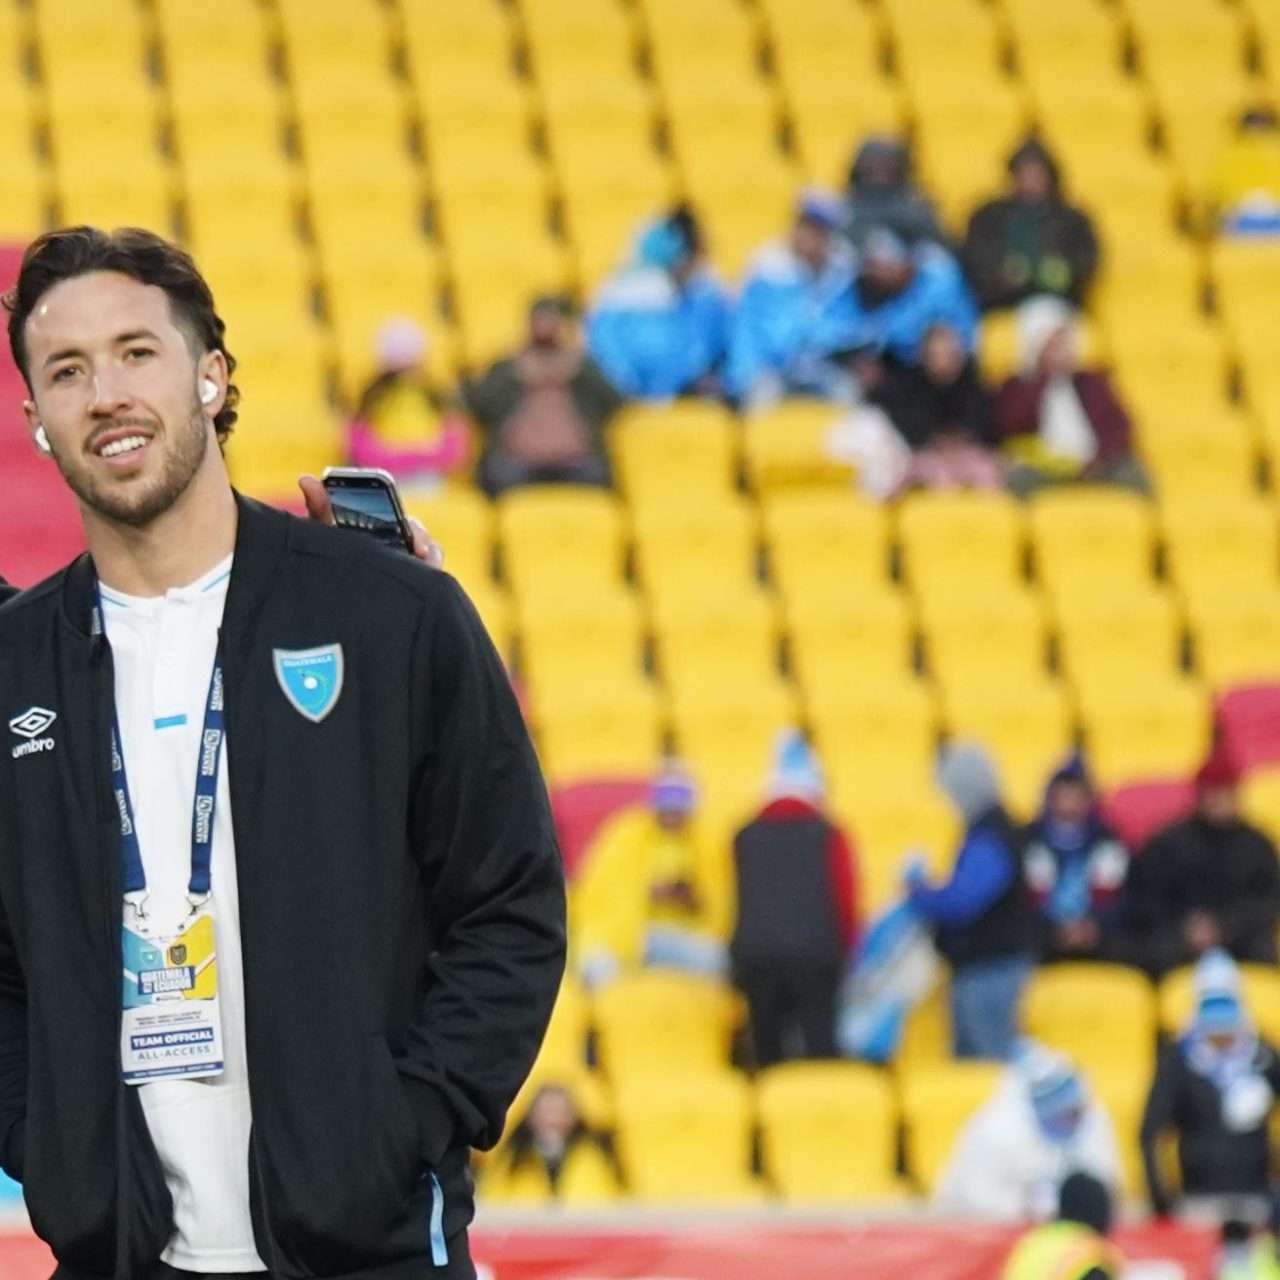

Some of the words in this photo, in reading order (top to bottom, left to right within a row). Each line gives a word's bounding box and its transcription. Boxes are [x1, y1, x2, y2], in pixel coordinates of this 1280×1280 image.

[12, 735, 55, 759] umbro
[133, 1035, 163, 1048] TEAM
[165, 1029, 214, 1045] OFFICIAL
